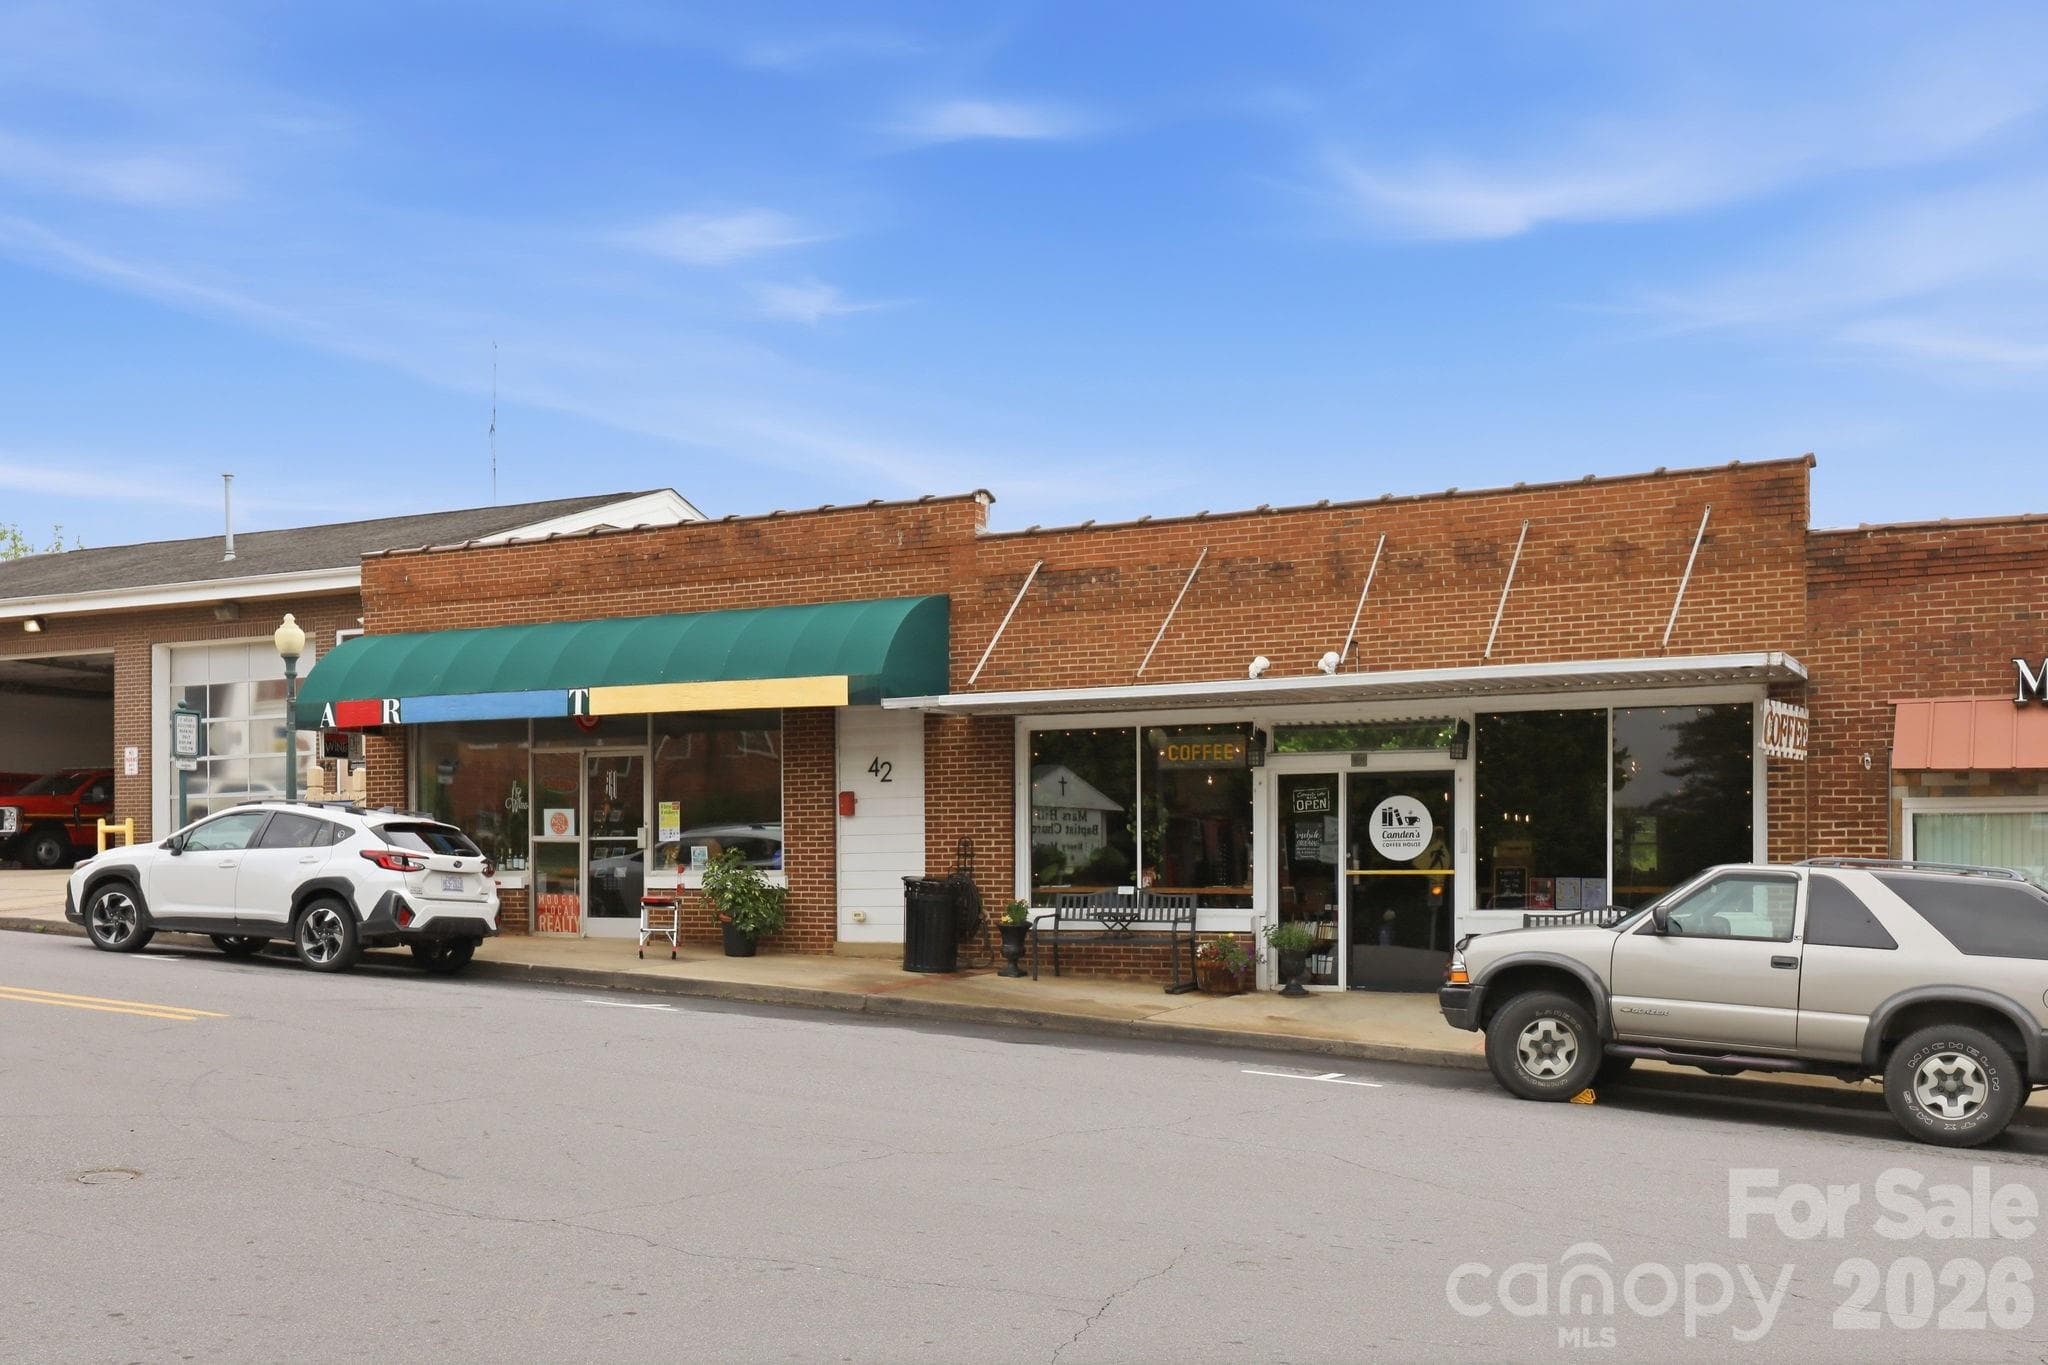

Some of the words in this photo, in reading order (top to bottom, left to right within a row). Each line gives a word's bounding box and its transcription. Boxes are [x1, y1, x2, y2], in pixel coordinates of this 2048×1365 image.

[1764, 709, 1809, 750] COFFEE
[1167, 743, 1234, 761] COFFEE
[868, 756, 892, 782] 42
[1296, 798, 1327, 811] OPEN
[1382, 829, 1420, 839] Camden's
[545, 905, 576, 915] LOCAL
[539, 913, 581, 934] REALTY
[1907, 1041, 2000, 1092] MICHELIN
[1944, 1112, 1989, 1131] LTX
